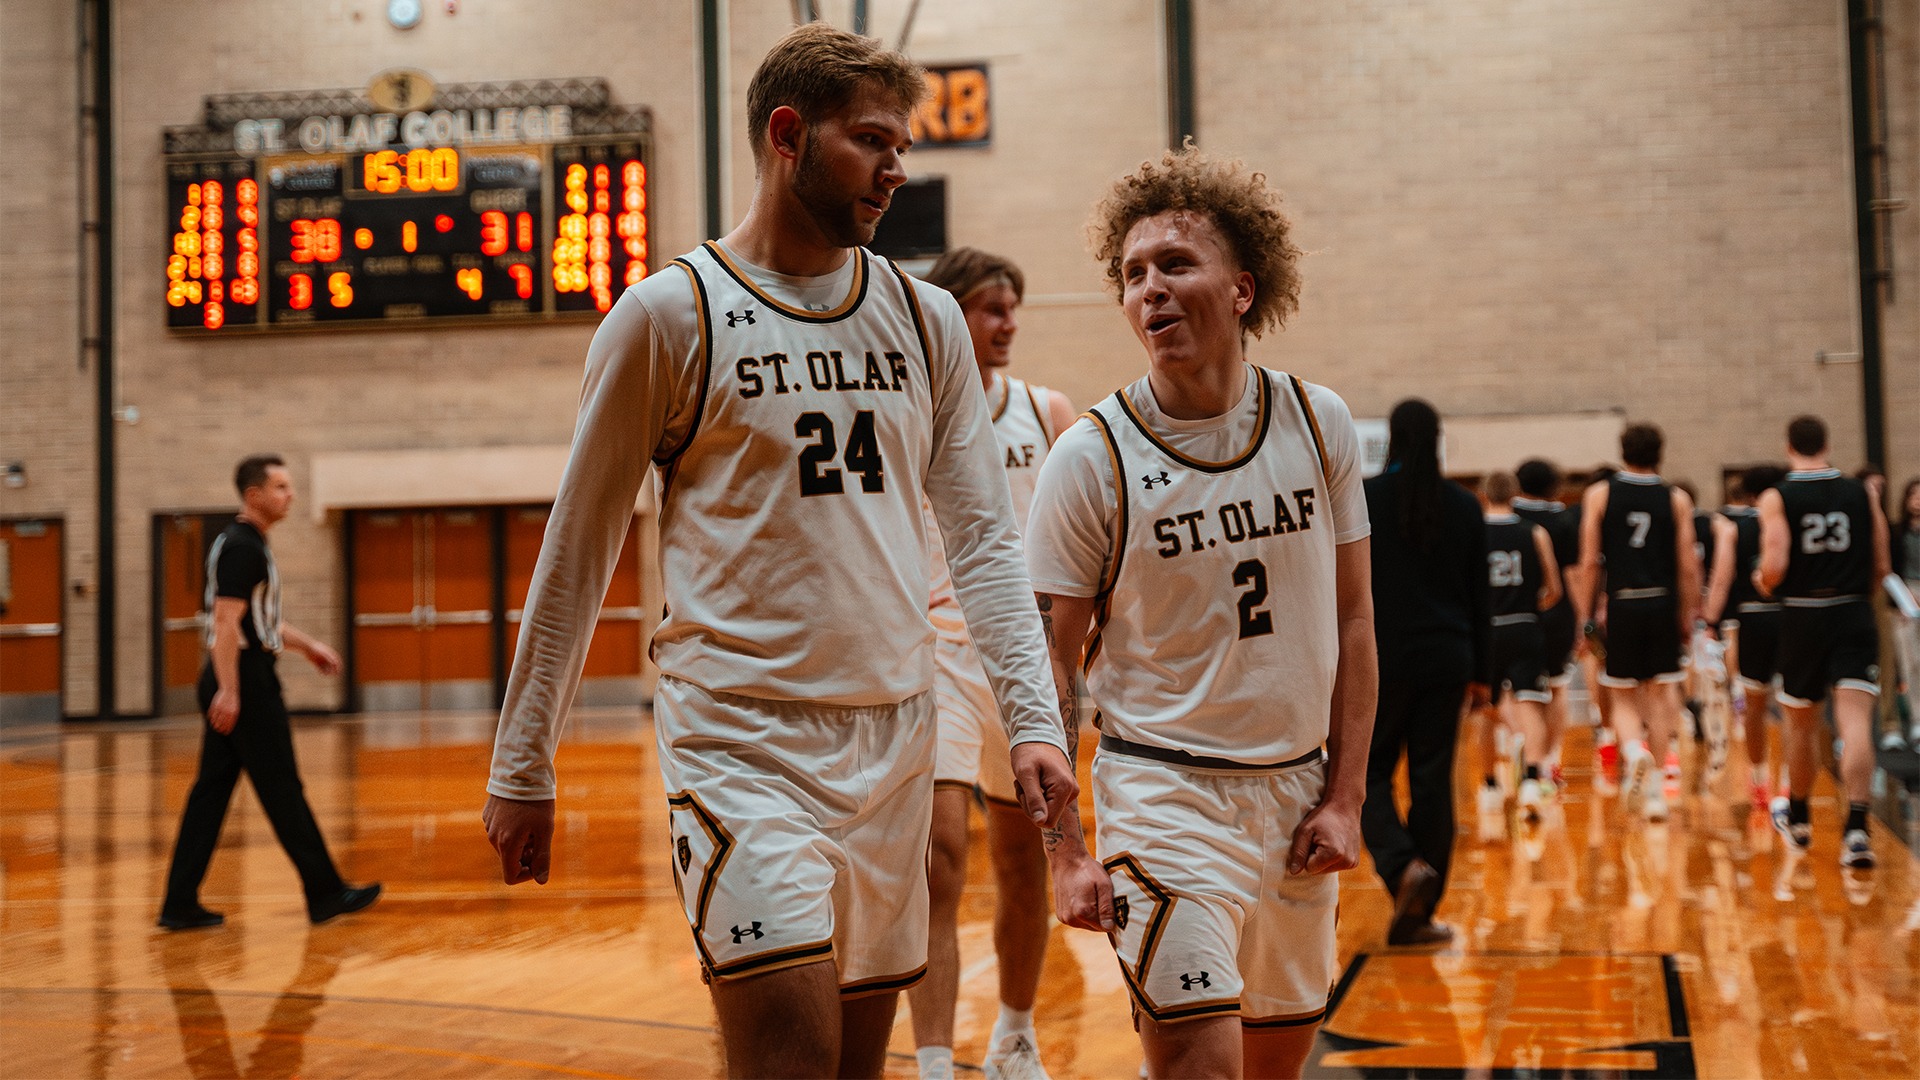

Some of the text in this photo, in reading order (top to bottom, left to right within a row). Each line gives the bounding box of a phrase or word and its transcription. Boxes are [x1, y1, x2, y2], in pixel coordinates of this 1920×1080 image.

[300, 113, 397, 154] OLAF
[401, 105, 572, 150] COLLEGE
[364, 147, 459, 193] 15:00
[291, 218, 341, 264] 38
[403, 220, 417, 252] 1
[481, 209, 532, 257] 31
[289, 273, 313, 310] 3
[328, 272, 353, 308] 5
[508, 263, 532, 299] 7
[735, 350, 908, 400] ST. OLAF
[793, 409, 885, 498] 24
[1153, 488, 1315, 559] ST. OLAF
[1625, 511, 1652, 548] 7
[1801, 511, 1851, 553] 23
[1487, 550, 1523, 586] 21
[1231, 558, 1274, 641] 2
